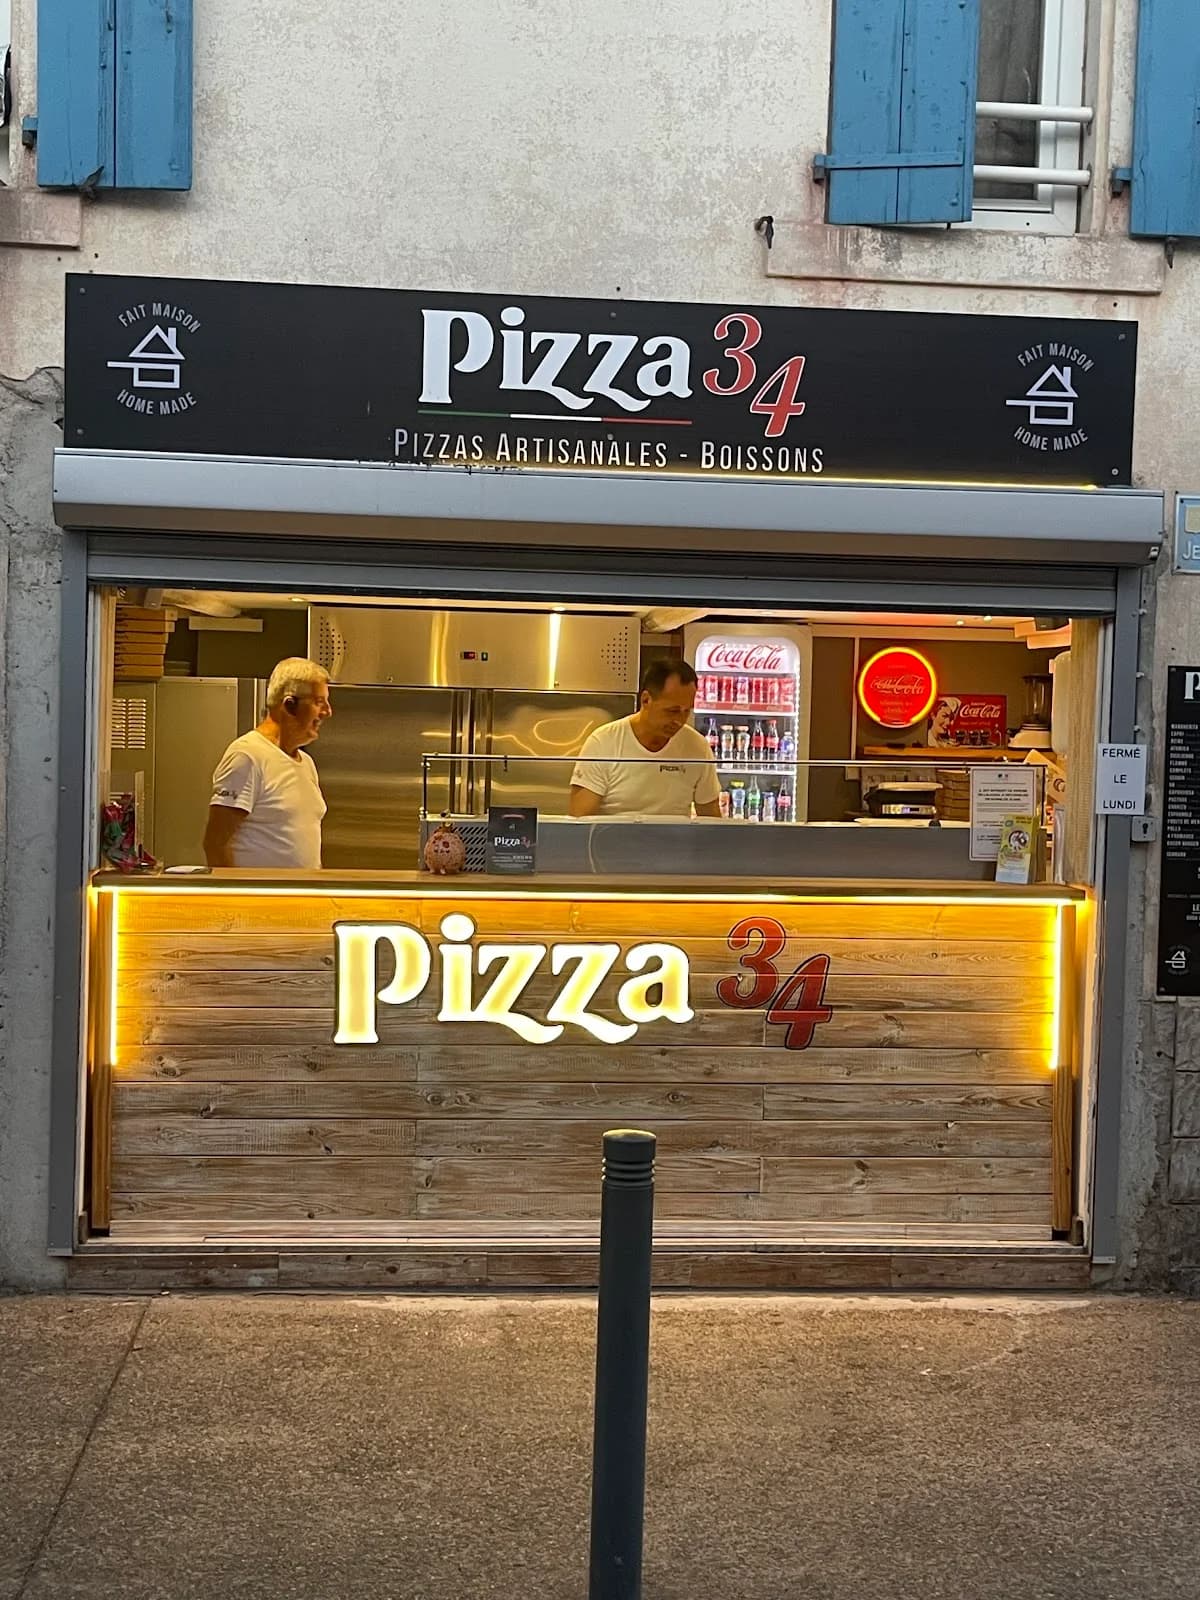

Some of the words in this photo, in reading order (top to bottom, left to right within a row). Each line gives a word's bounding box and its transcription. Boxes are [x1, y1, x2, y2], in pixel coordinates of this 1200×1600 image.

[118, 304, 146, 327] FAIT
[152, 302, 201, 333] MAISON
[1017, 344, 1044, 367] FAIT
[1049, 343, 1095, 372] MAISON
[418, 306, 693, 412] Pizza
[702, 313, 806, 438] 34
[117, 389, 154, 415] HOME
[159, 392, 198, 415] MADE
[1013, 426, 1049, 451] HOME
[1053, 429, 1089, 451] MADE
[707, 643, 784, 670] Coca-Cola
[960, 704, 1001, 718] Coca-Cola
[1102, 747, 1141, 759] FERMÉ
[1114, 774, 1128, 784] LE
[1103, 800, 1136, 810] LUNDI
[494, 836, 520, 848] Pizza
[333, 912, 695, 1045] Pizza
[717, 916, 833, 1051] 34
